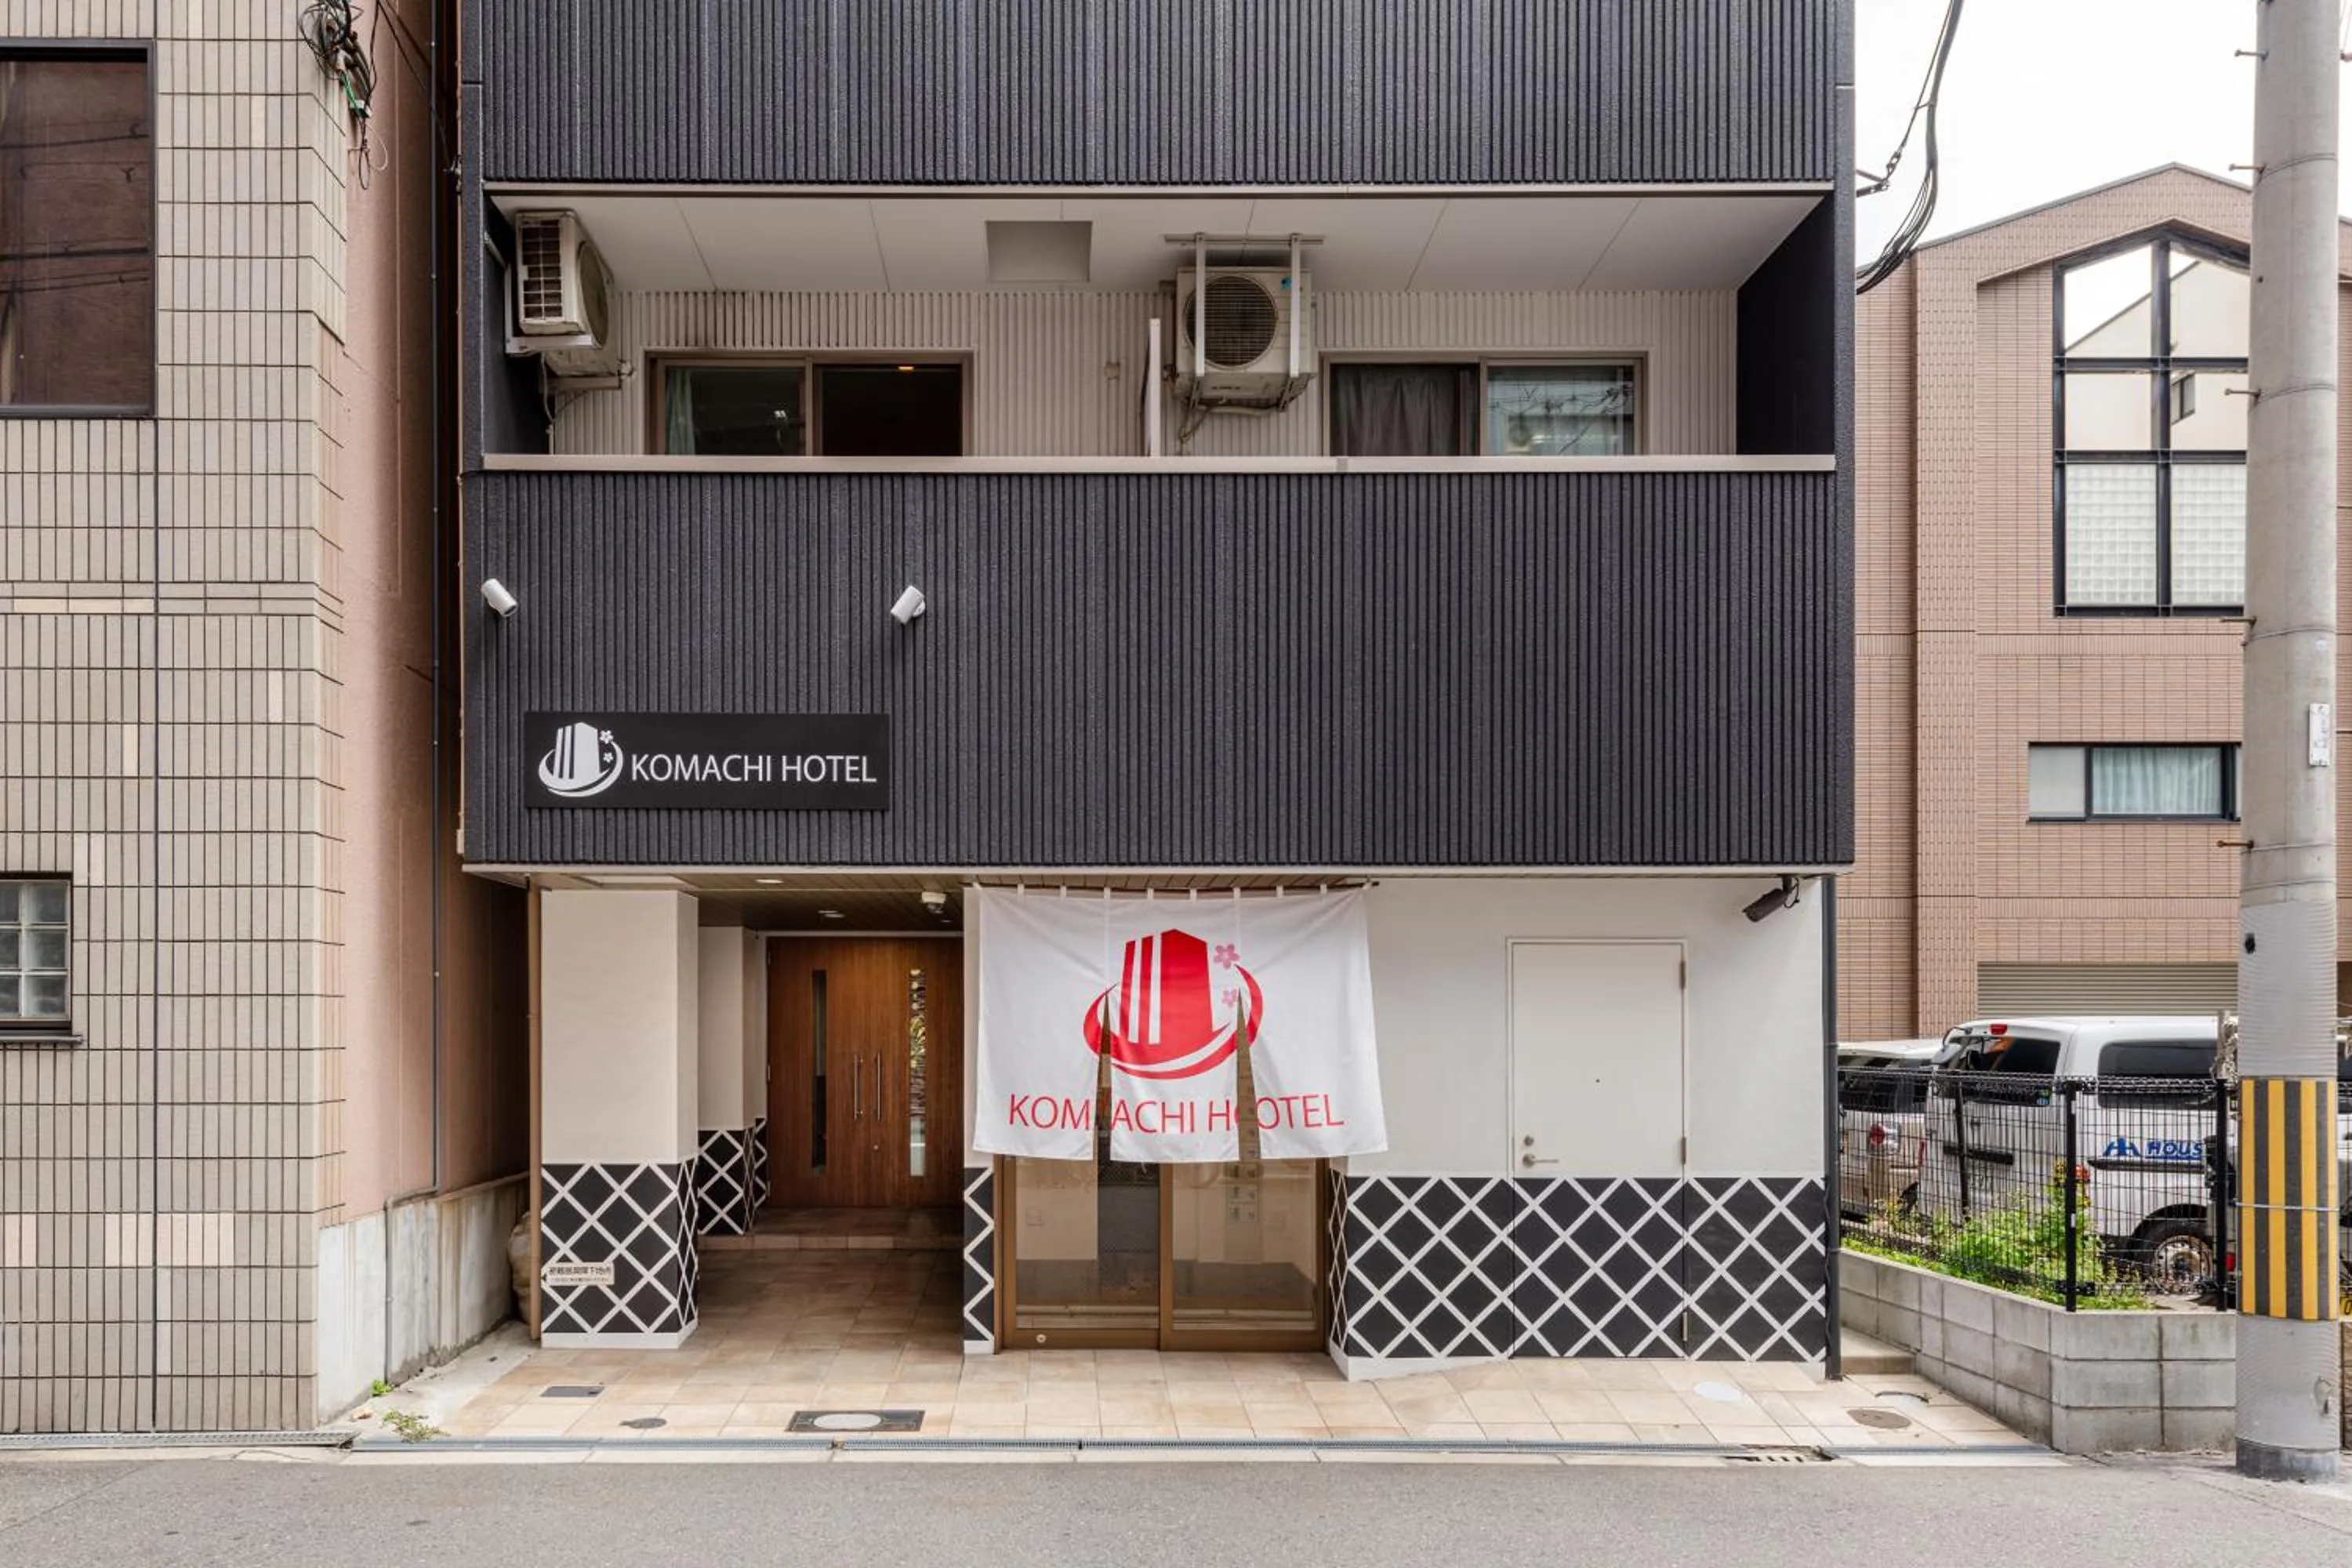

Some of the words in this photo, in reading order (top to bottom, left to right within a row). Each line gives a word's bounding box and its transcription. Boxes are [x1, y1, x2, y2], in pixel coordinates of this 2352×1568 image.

[631, 753, 771, 782] KOMACHI
[782, 754, 877, 782] HOTEL
[1008, 1093, 1196, 1134] KOMACHI
[1208, 1094, 1345, 1134] HOTEL
